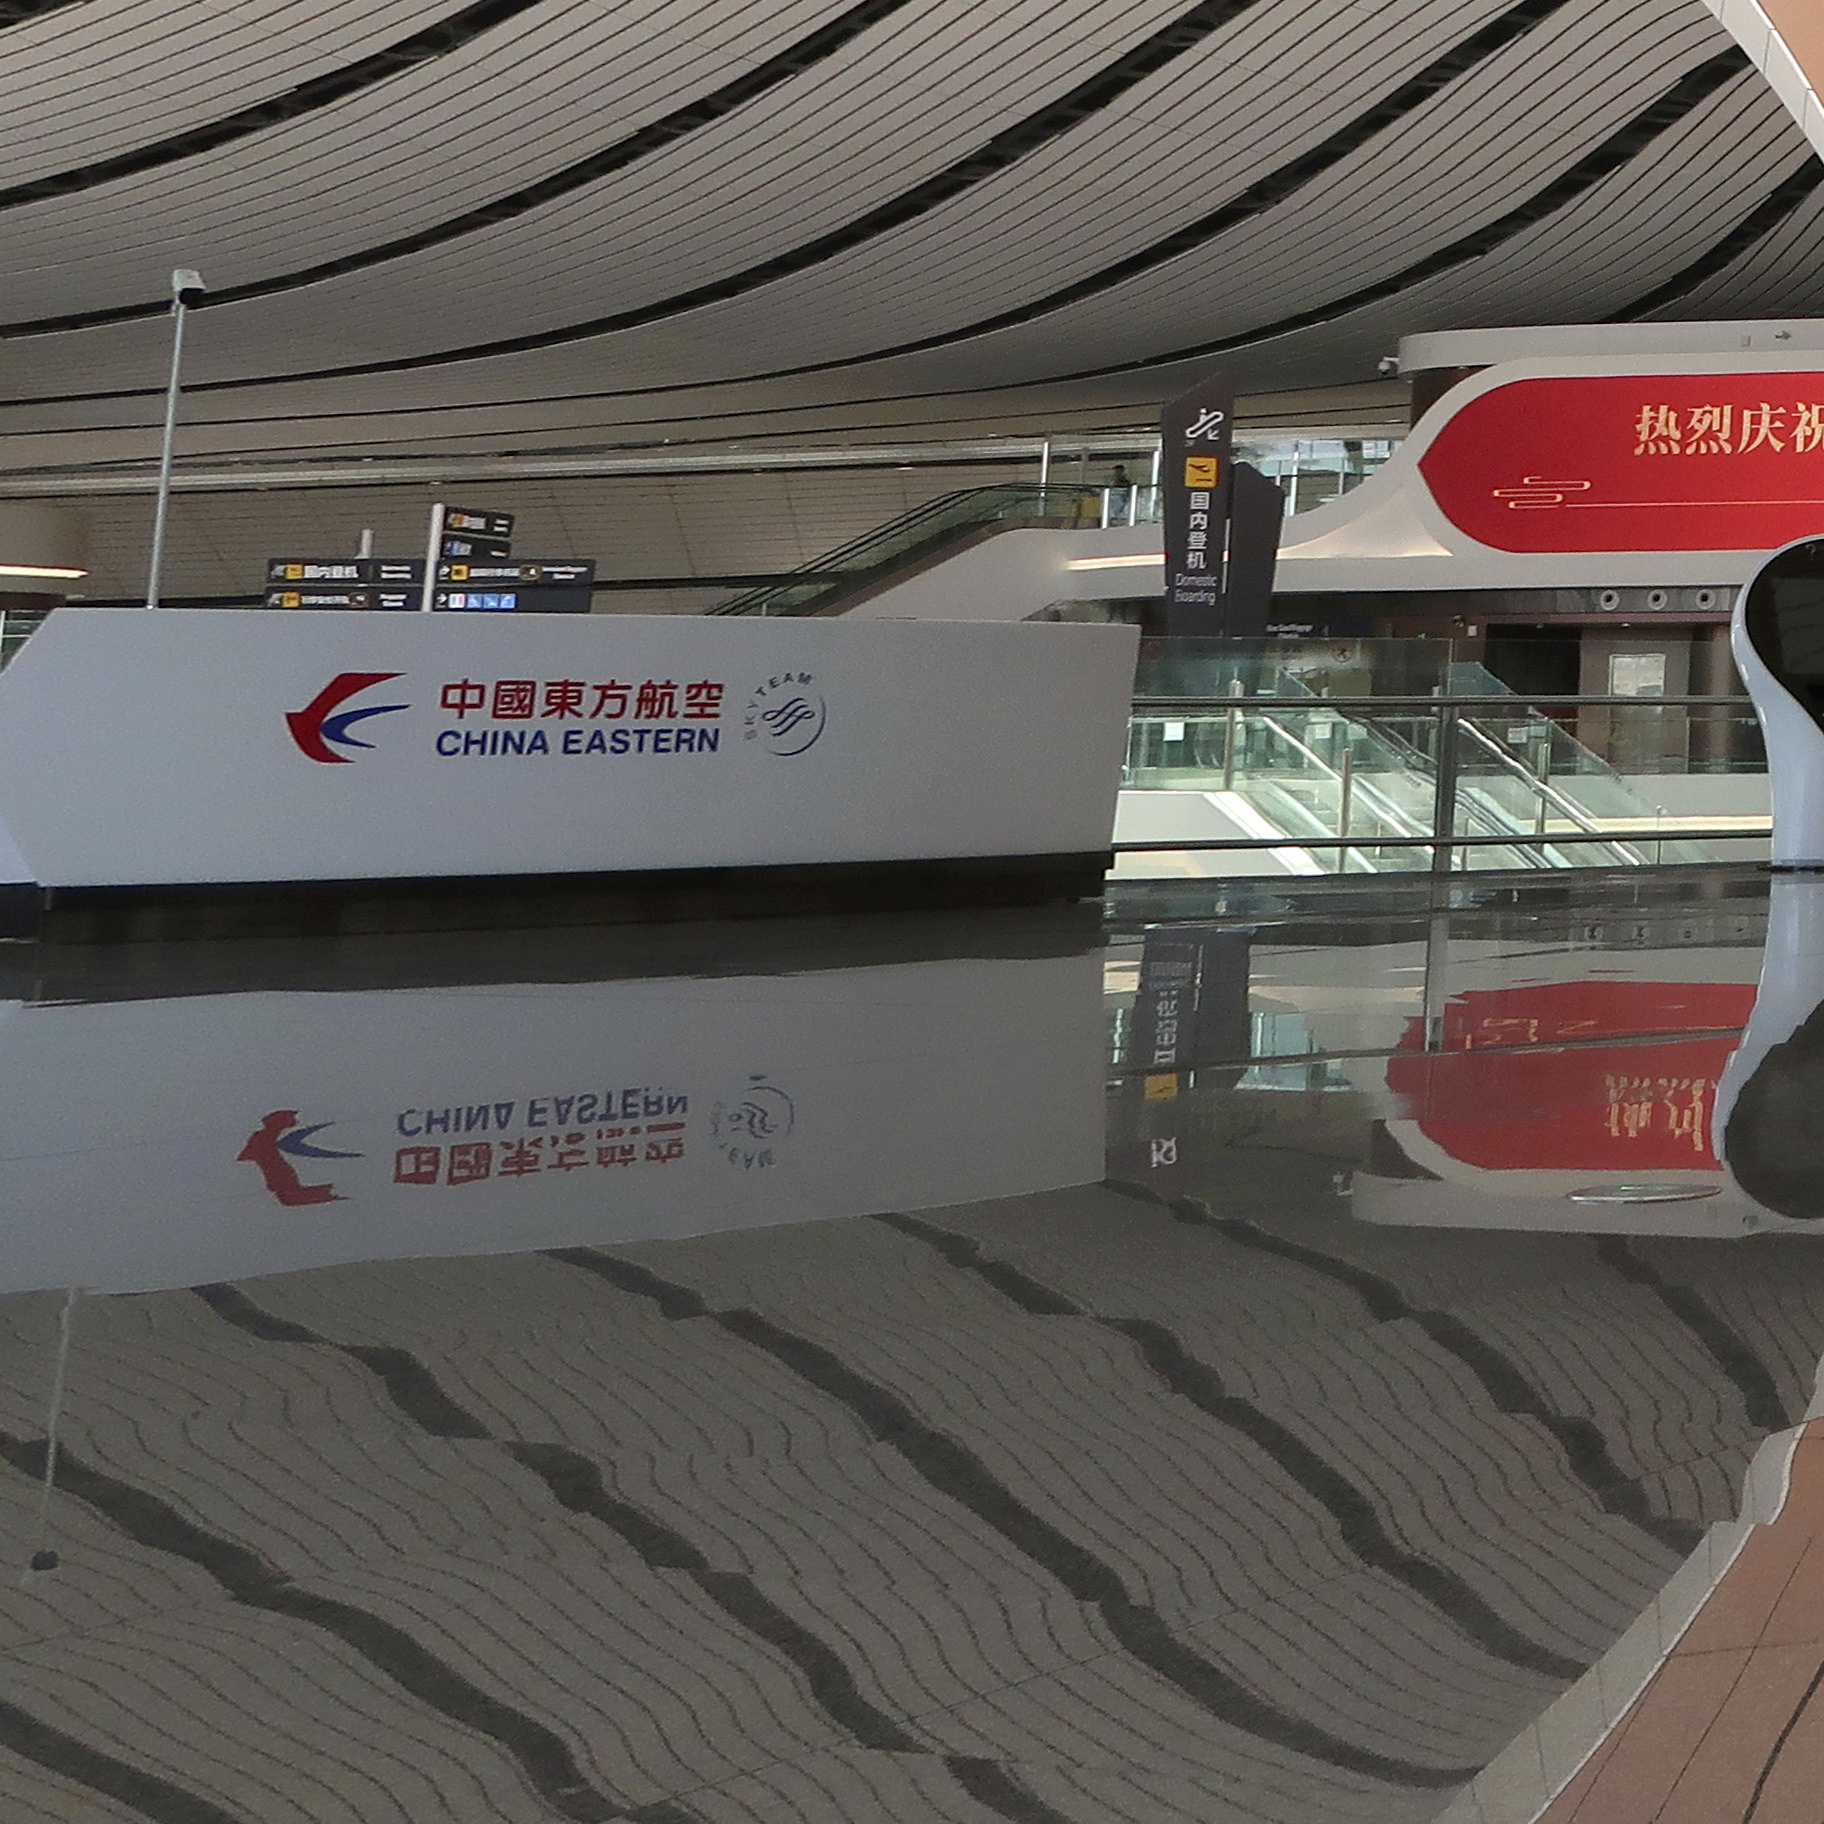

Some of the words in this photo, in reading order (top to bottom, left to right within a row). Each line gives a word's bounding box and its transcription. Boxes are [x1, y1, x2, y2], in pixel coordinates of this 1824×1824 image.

[1187, 491, 1210, 570] 国内登机
[1175, 572, 1218, 587] Domestic
[1174, 588, 1216, 606] Boarding
[440, 678, 724, 720] 中國東方航空
[436, 729, 549, 758] CHINA
[562, 727, 720, 755] EASTERN
